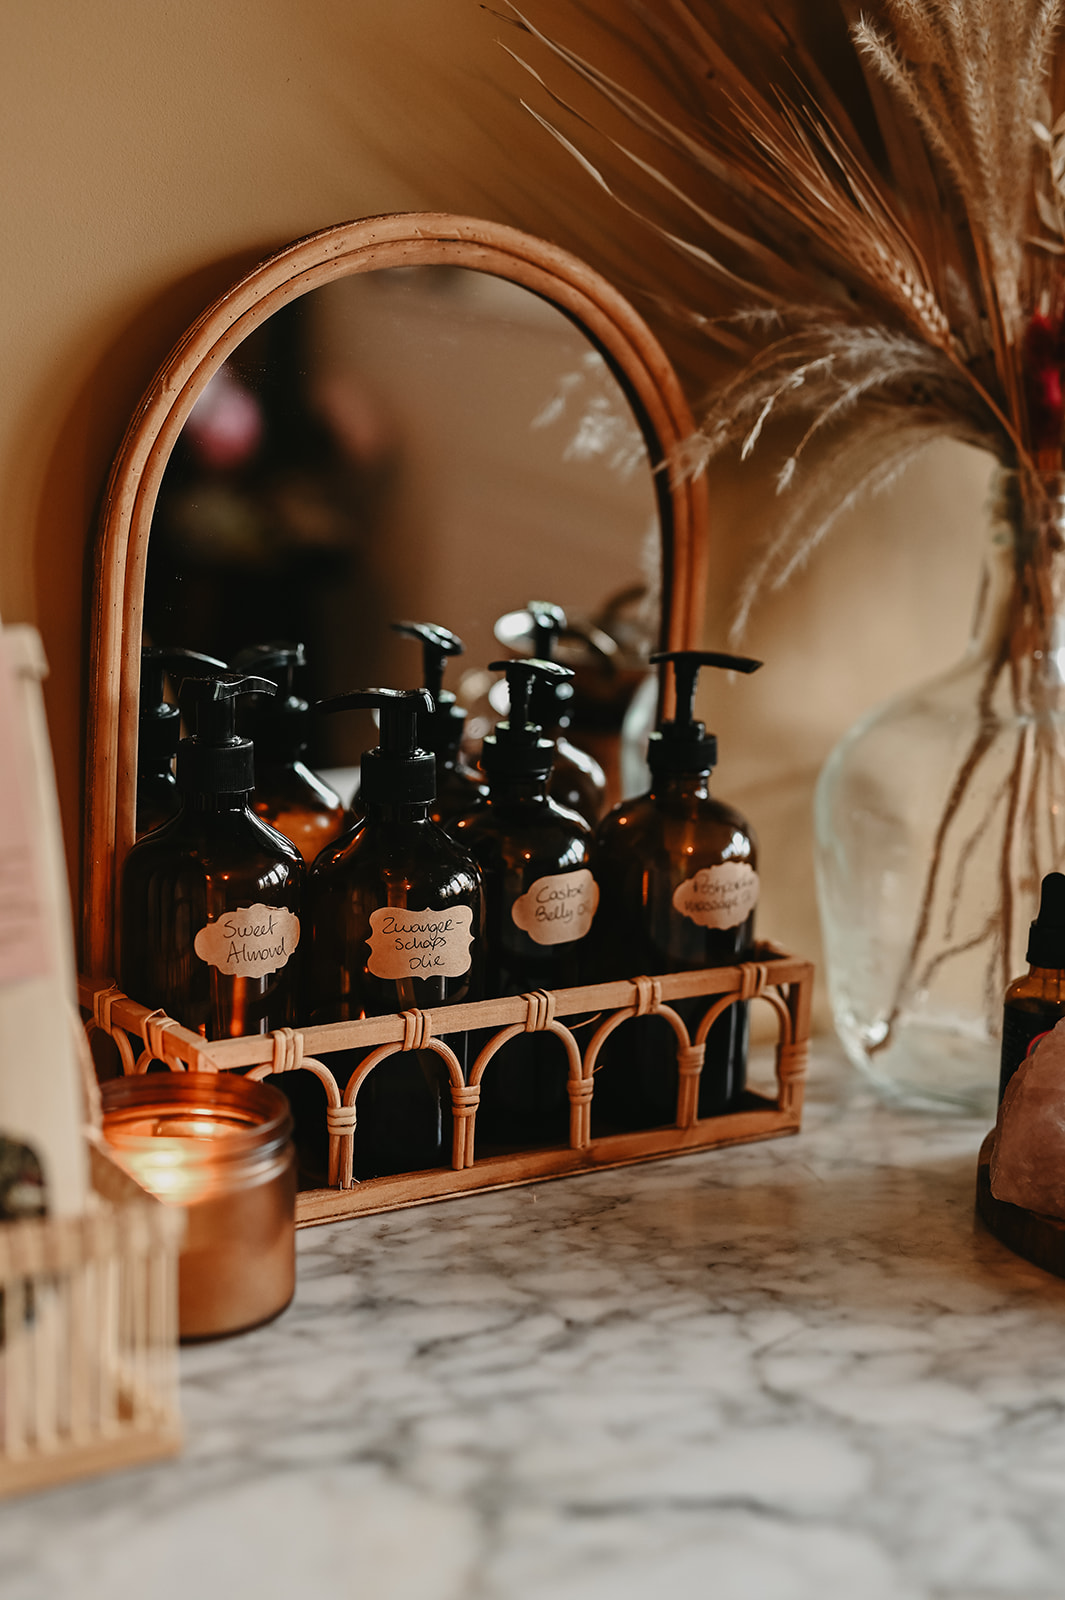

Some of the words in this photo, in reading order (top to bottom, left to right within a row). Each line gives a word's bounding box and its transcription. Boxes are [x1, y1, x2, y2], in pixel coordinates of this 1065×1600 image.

[534, 901, 574, 924] Belly
[222, 914, 279, 939] Sweet
[226, 936, 288, 964] Almond
